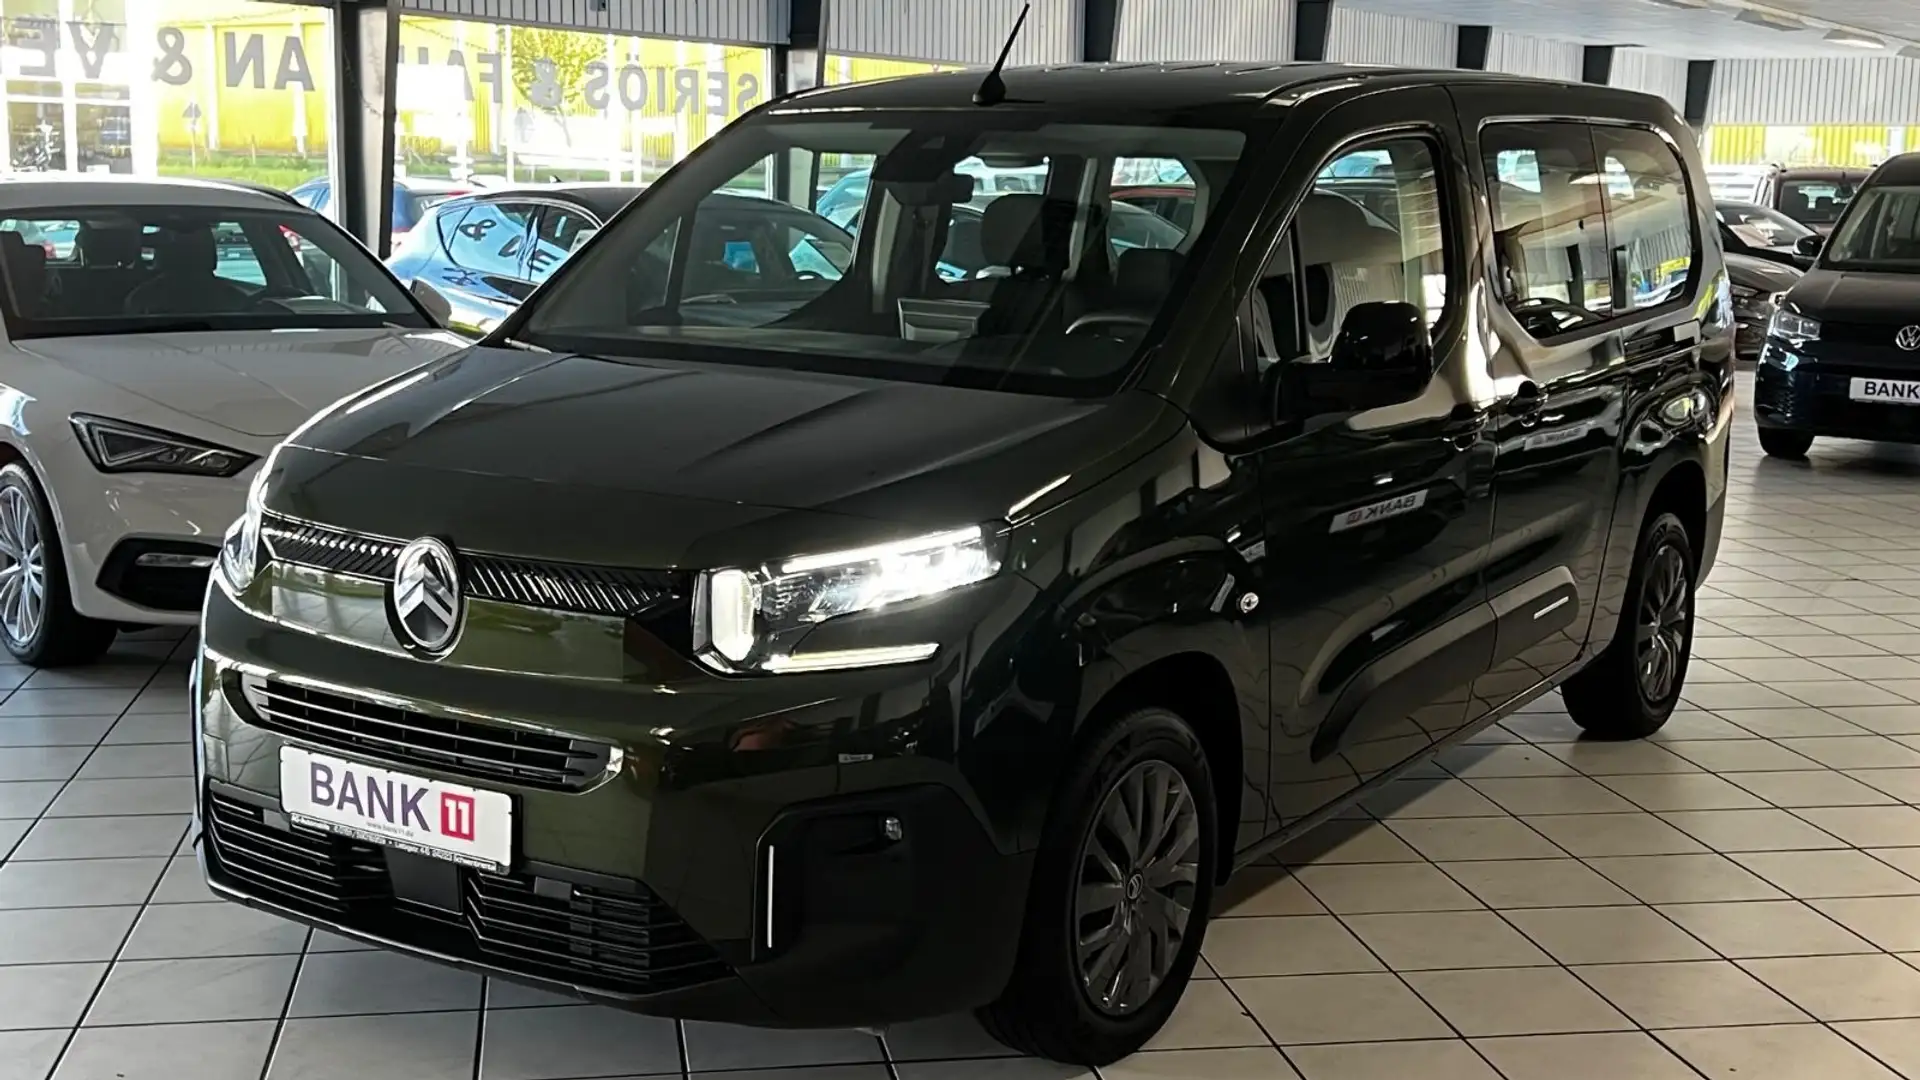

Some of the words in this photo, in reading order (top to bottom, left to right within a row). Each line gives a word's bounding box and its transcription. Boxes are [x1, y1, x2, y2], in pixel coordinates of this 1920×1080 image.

[1864, 381, 1920, 399] BANK
[310, 761, 431, 833] BANK
[443, 796, 471, 837] 11
